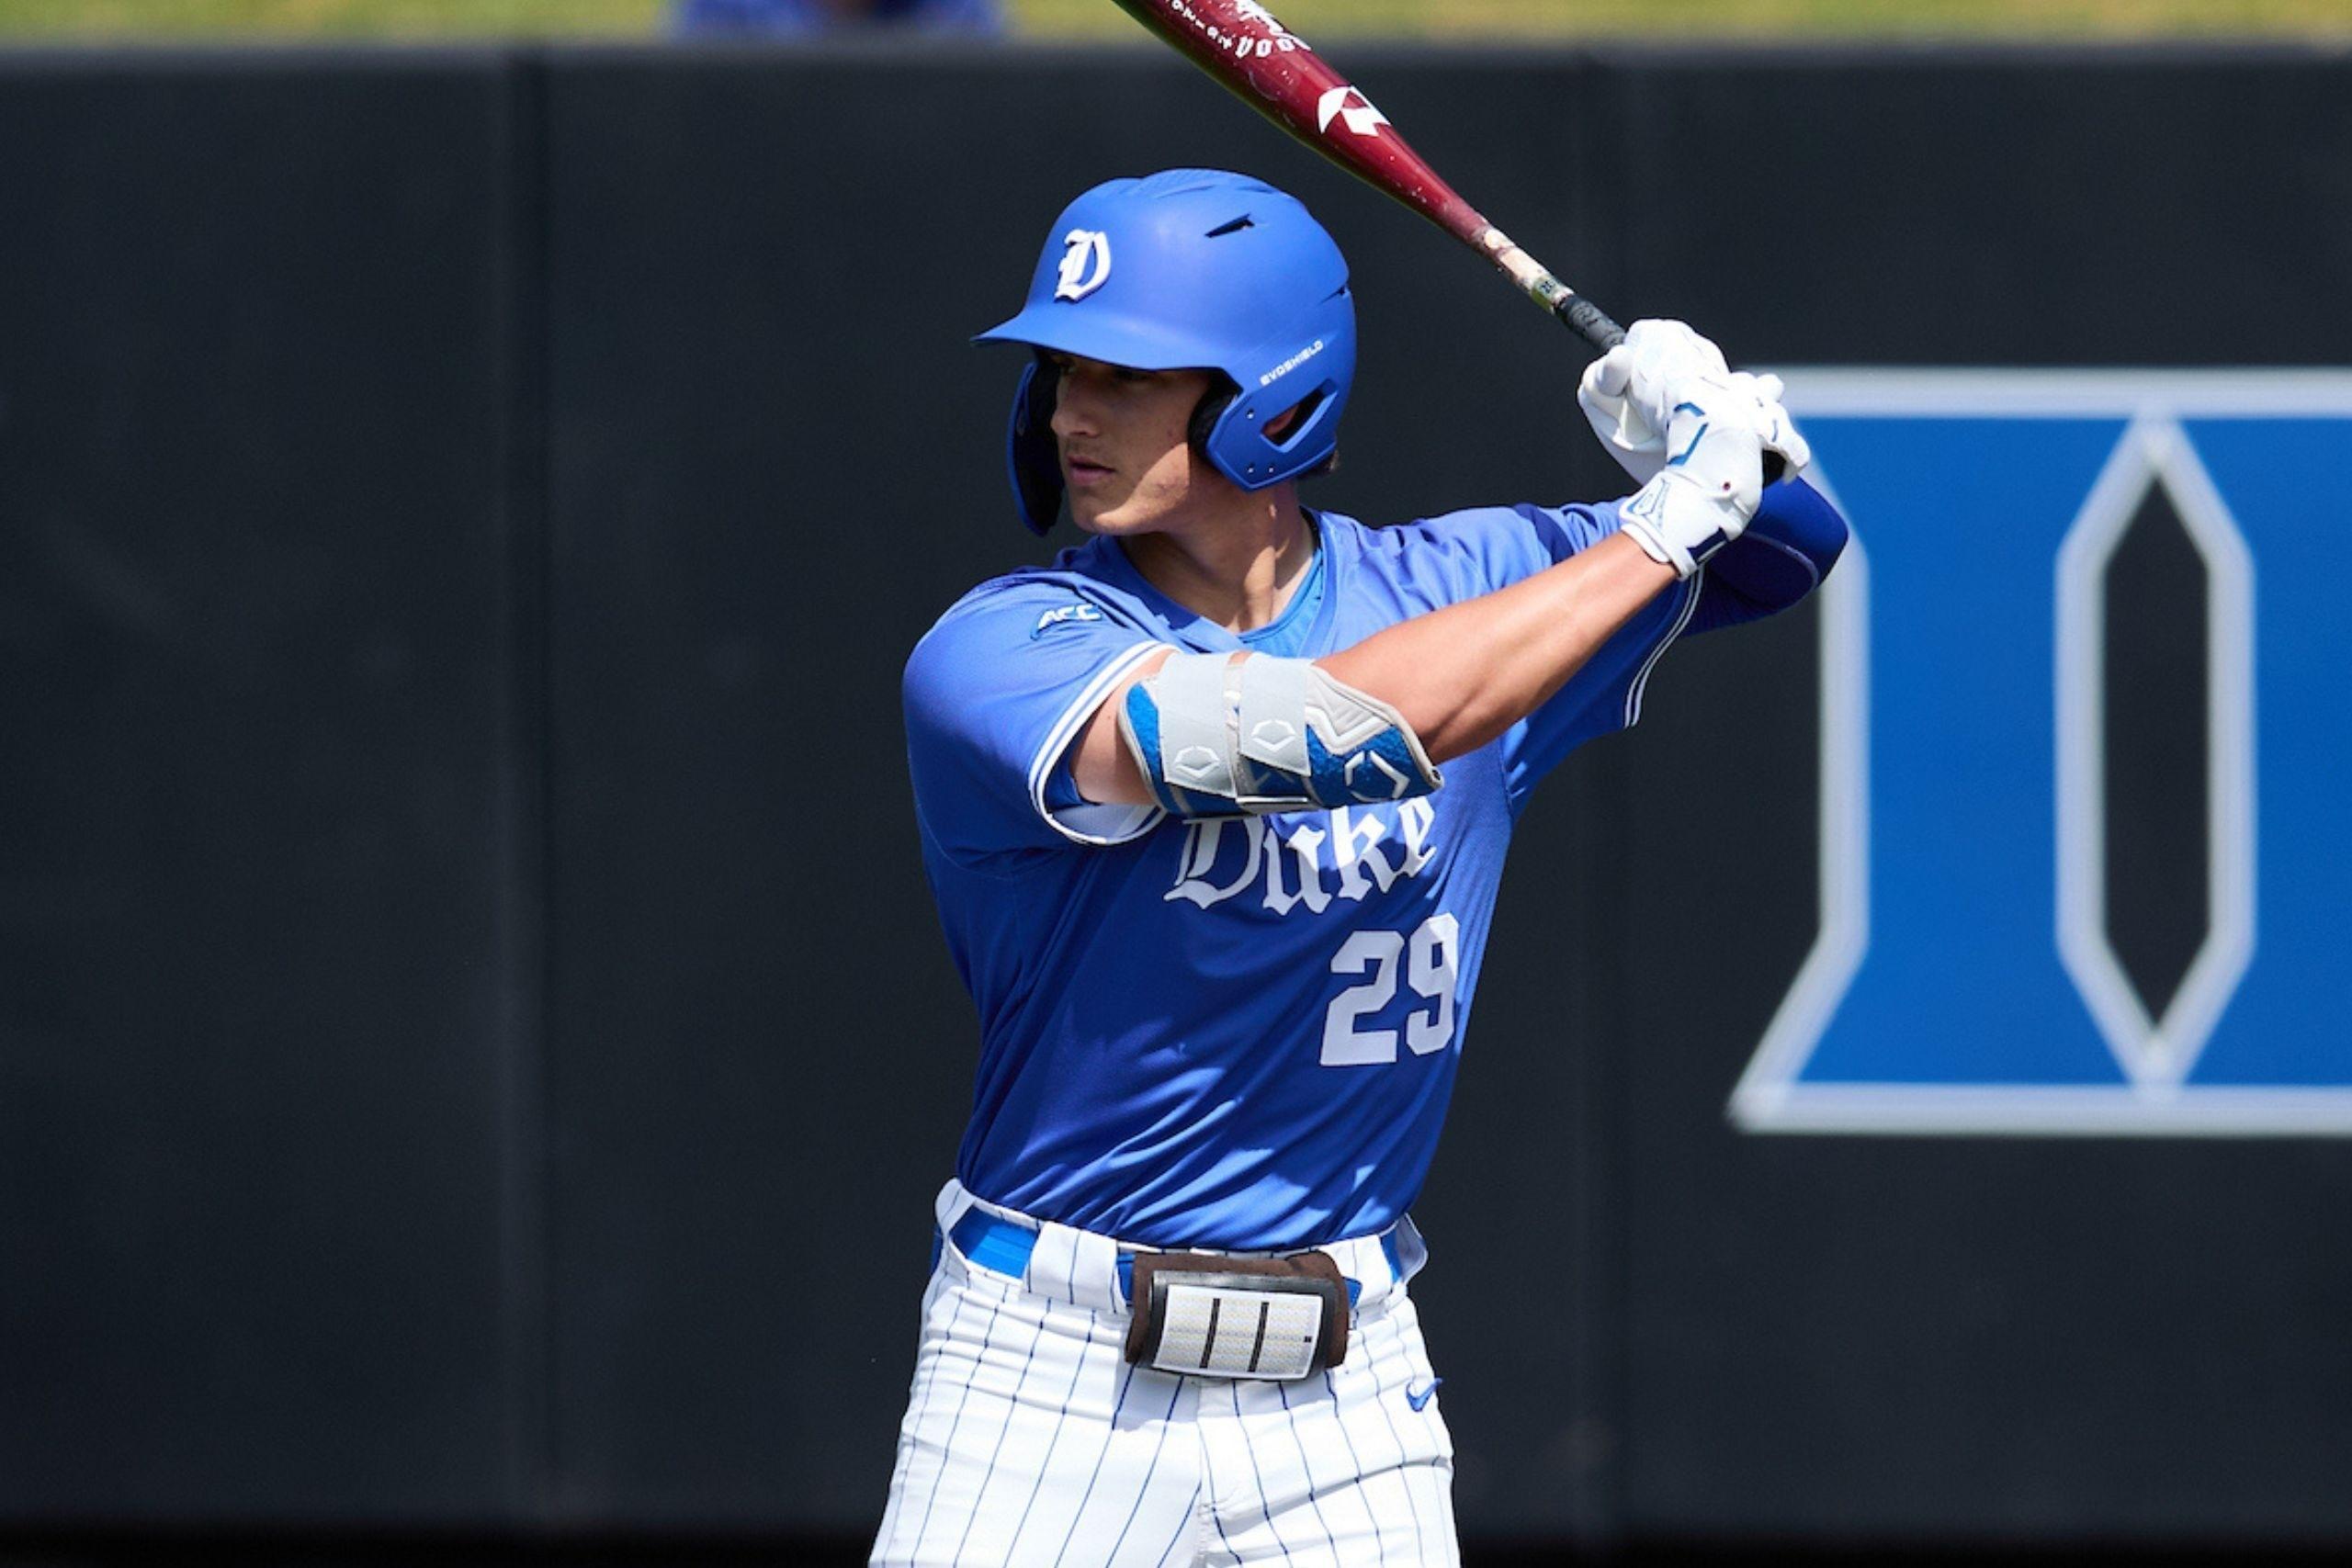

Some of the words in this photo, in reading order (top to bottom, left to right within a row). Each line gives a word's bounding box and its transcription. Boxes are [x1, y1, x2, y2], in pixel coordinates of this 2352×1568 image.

[1055, 229, 1112, 302] D
[1260, 340, 1324, 387] EVOSHIELD
[1037, 604, 1101, 630] ACC
[1163, 795, 1436, 916] Duke
[1320, 912, 1459, 1066] 29
